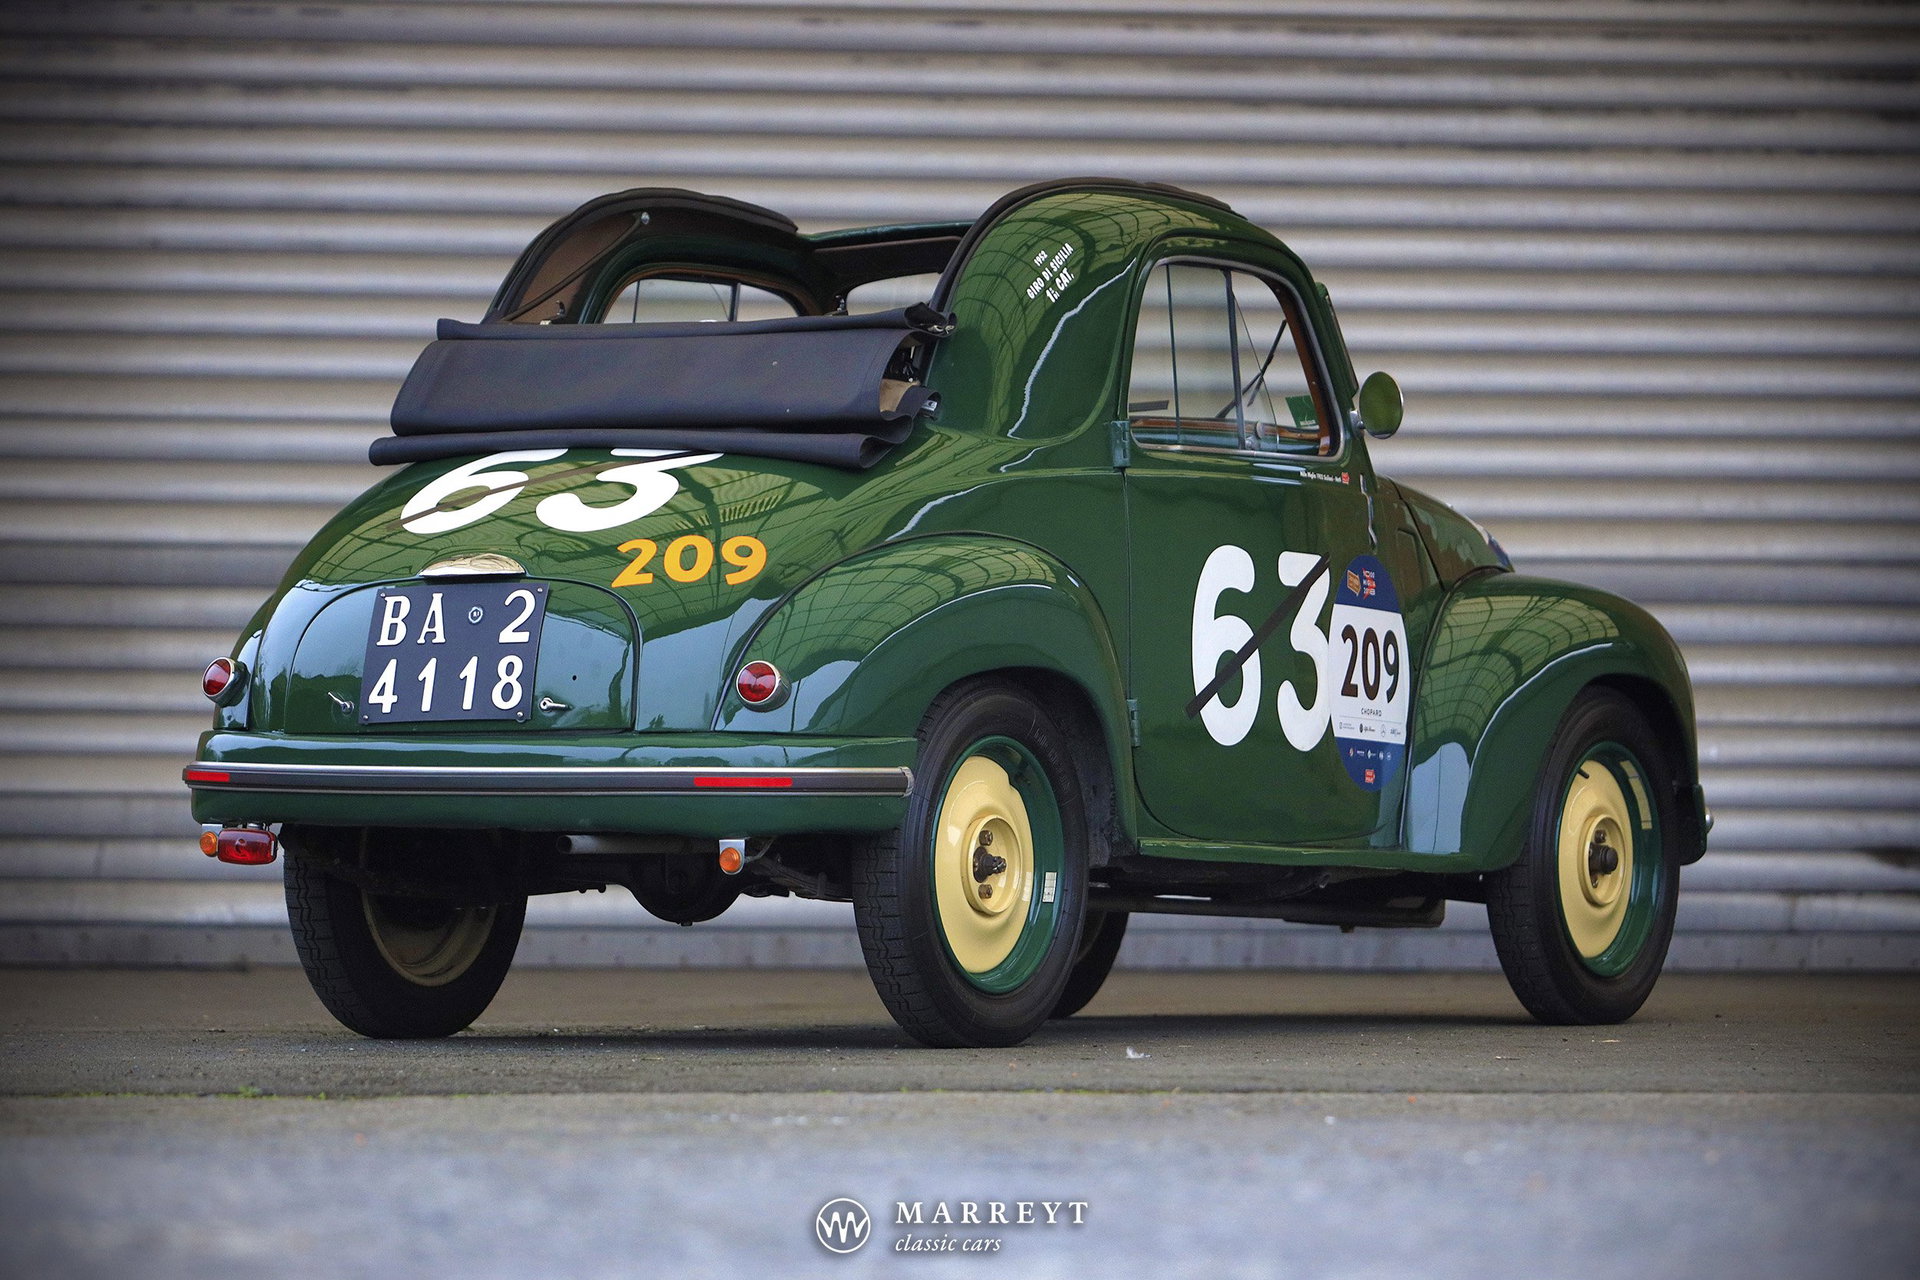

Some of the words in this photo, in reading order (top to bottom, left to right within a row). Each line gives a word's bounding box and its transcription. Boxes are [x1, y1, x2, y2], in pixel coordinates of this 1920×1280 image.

[1026, 277, 1045, 299] GIRO
[1041, 267, 1053, 281] DI
[1050, 242, 1074, 272] SICILIA
[1033, 250, 1048, 267] 1952
[400, 448, 724, 534] 63
[611, 534, 767, 588] 209
[376, 592, 446, 646] BA
[498, 589, 536, 644] 2
[1192, 544, 1331, 752] 63
[1341, 624, 1400, 704] 209
[368, 654, 524, 714] 4118
[1360, 707, 1383, 717] CHOPARD
